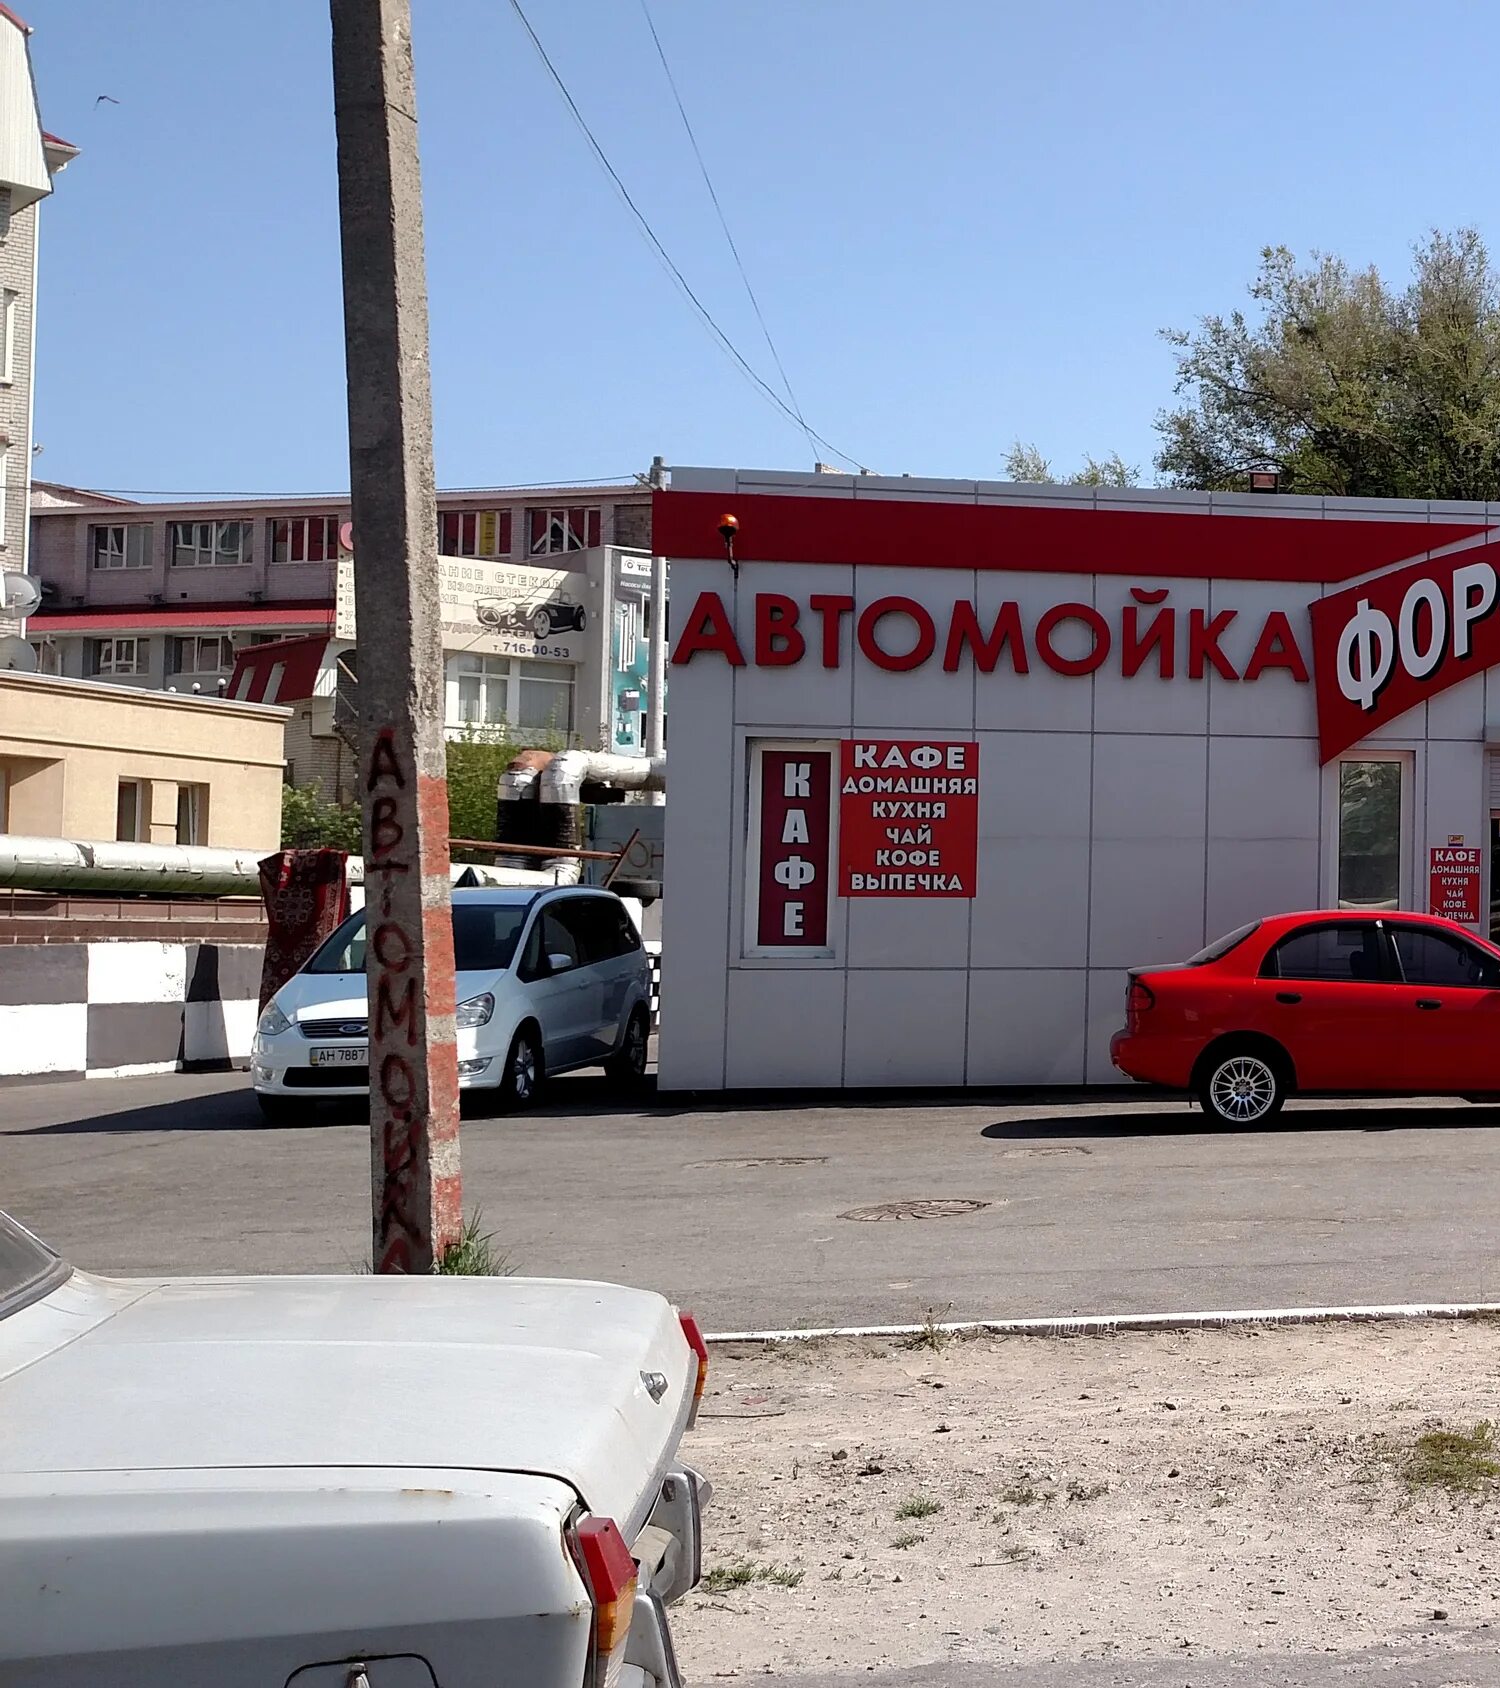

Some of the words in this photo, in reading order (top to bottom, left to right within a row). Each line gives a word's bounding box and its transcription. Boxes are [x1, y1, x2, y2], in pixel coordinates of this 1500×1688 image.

[671, 587, 1310, 683] АВТОМОЙКА
[854, 744, 965, 769] КАФЕ
[842, 776, 977, 795] ДОМАШНЯЯ
[872, 801, 946, 819] КУХНЯ
[886, 824, 932, 844] ЧАЙ
[774, 762, 816, 936] КАФЕ
[1435, 850, 1476, 862] КАФЕ
[876, 850, 940, 867] КОФЕ
[1431, 865, 1480, 875] ДОМАШНЯЯ
[851, 873, 963, 891] ВЫПЕЧКА
[1441, 877, 1469, 886] КУХНЯ
[1446, 888, 1464, 898] ЧАЙ
[1443, 900, 1467, 909] КОФЕ
[337, 1049, 366, 1061] 7887
